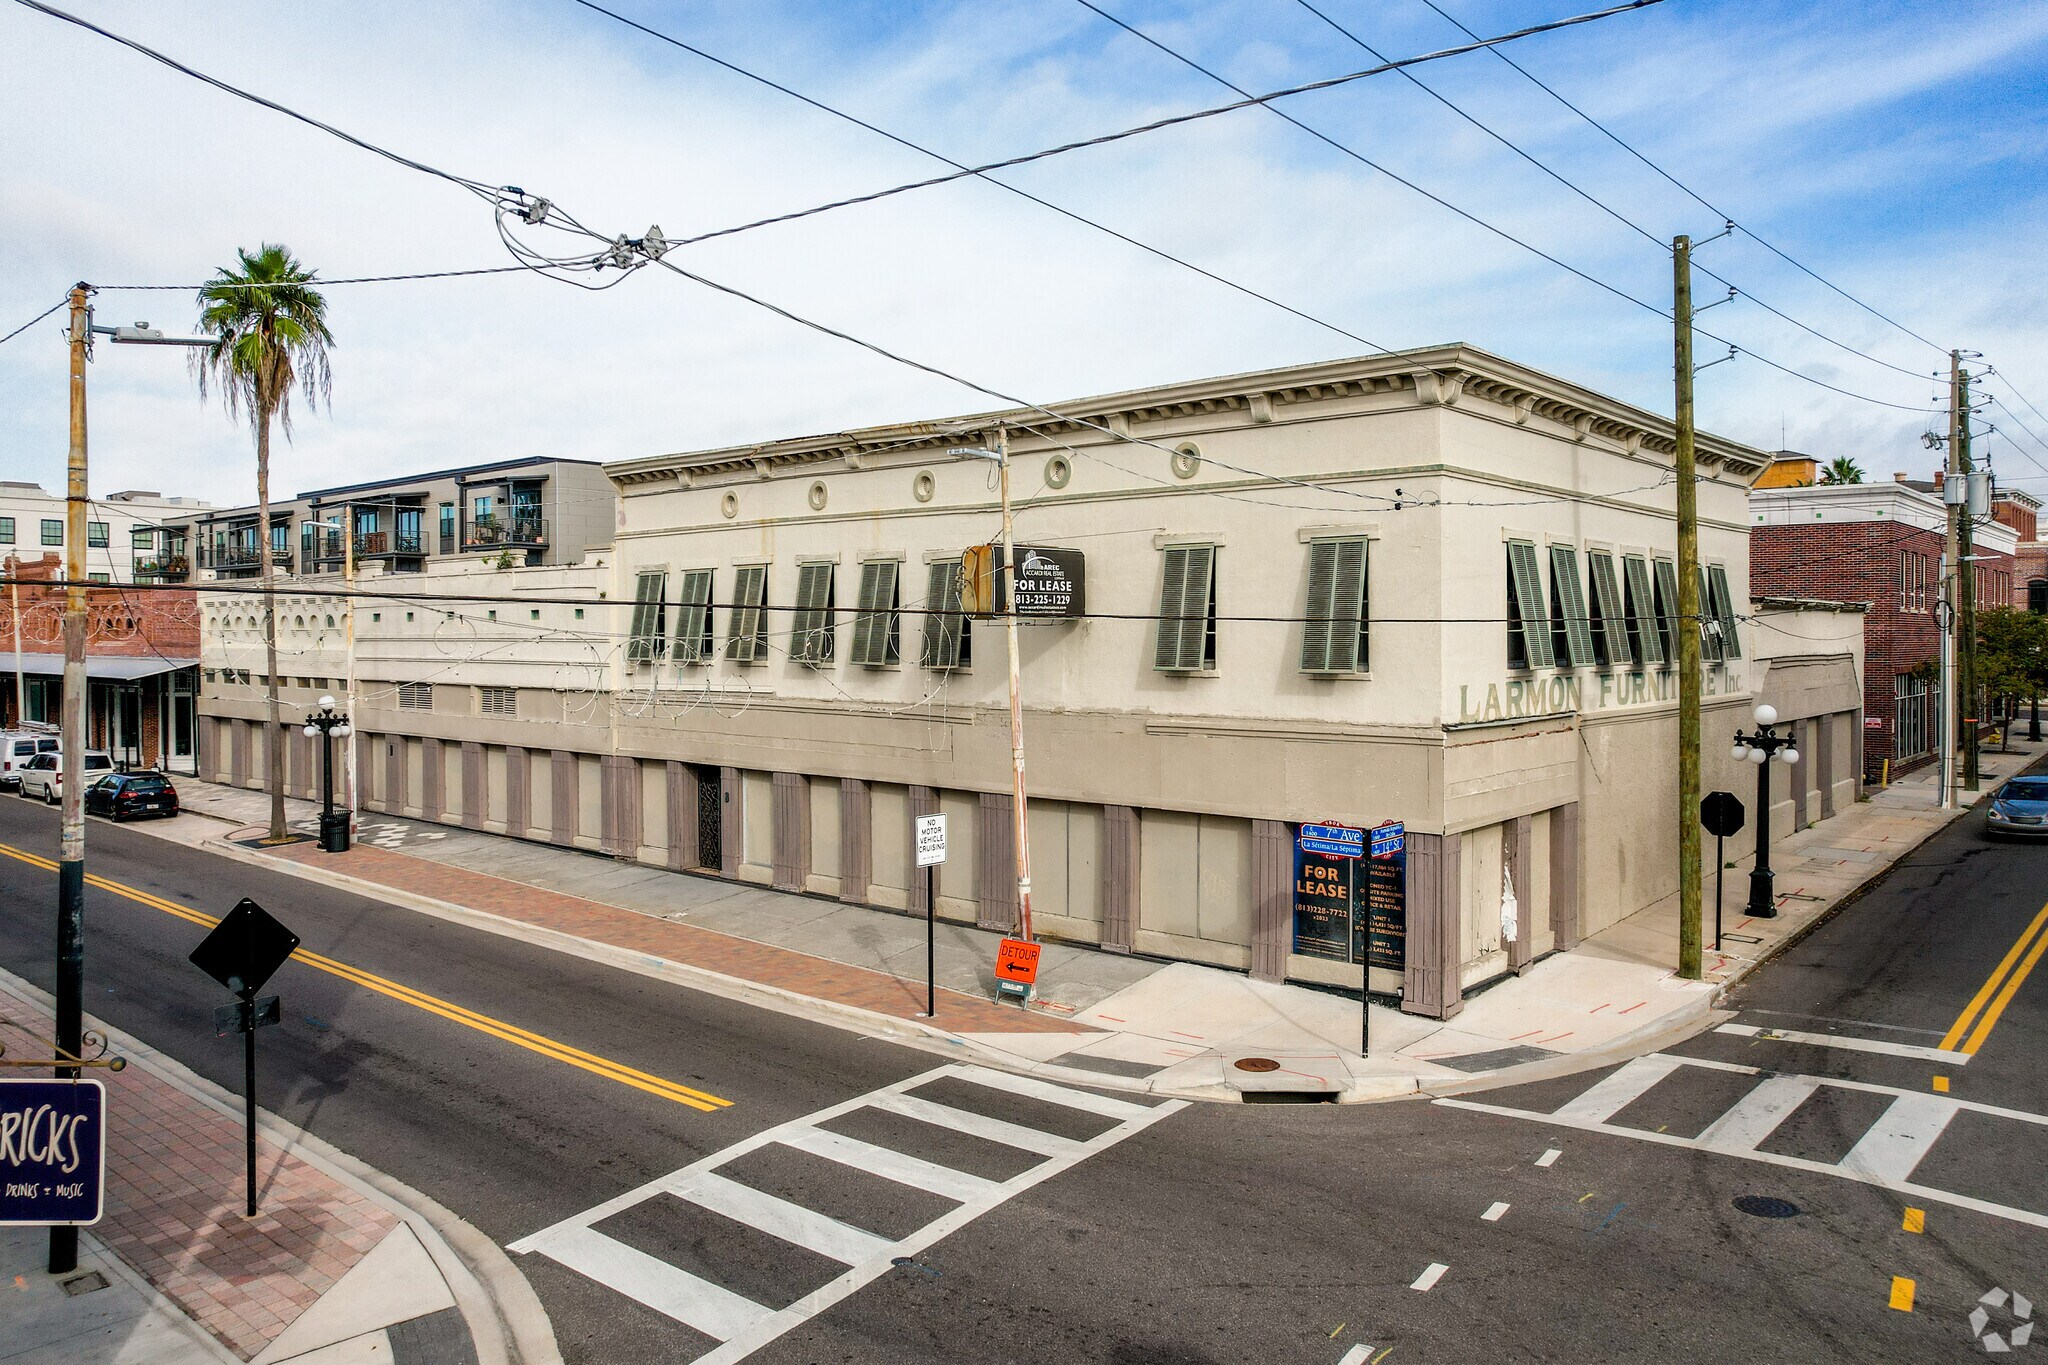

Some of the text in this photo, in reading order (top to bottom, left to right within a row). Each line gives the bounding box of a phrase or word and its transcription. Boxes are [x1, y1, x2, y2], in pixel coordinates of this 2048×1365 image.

[1013, 579, 1072, 592] FOR LEASE
[1015, 594, 1071, 605] 813-225-1229
[1459, 676, 1583, 722] LARMON
[1599, 667, 1717, 708] FURNITE
[921, 826, 942, 836] MOTOR
[1326, 828, 1360, 842] 7th Ave
[919, 834, 944, 845] VEHICLE
[918, 842, 945, 853] CRUISING
[1304, 864, 1339, 881] FOR
[1296, 879, 1347, 899] LEASE
[1295, 903, 1347, 918] (813)228-7722
[1001, 945, 1037, 961] DETOUR
[5, 1183, 84, 1199] DRINKS MUSIC
